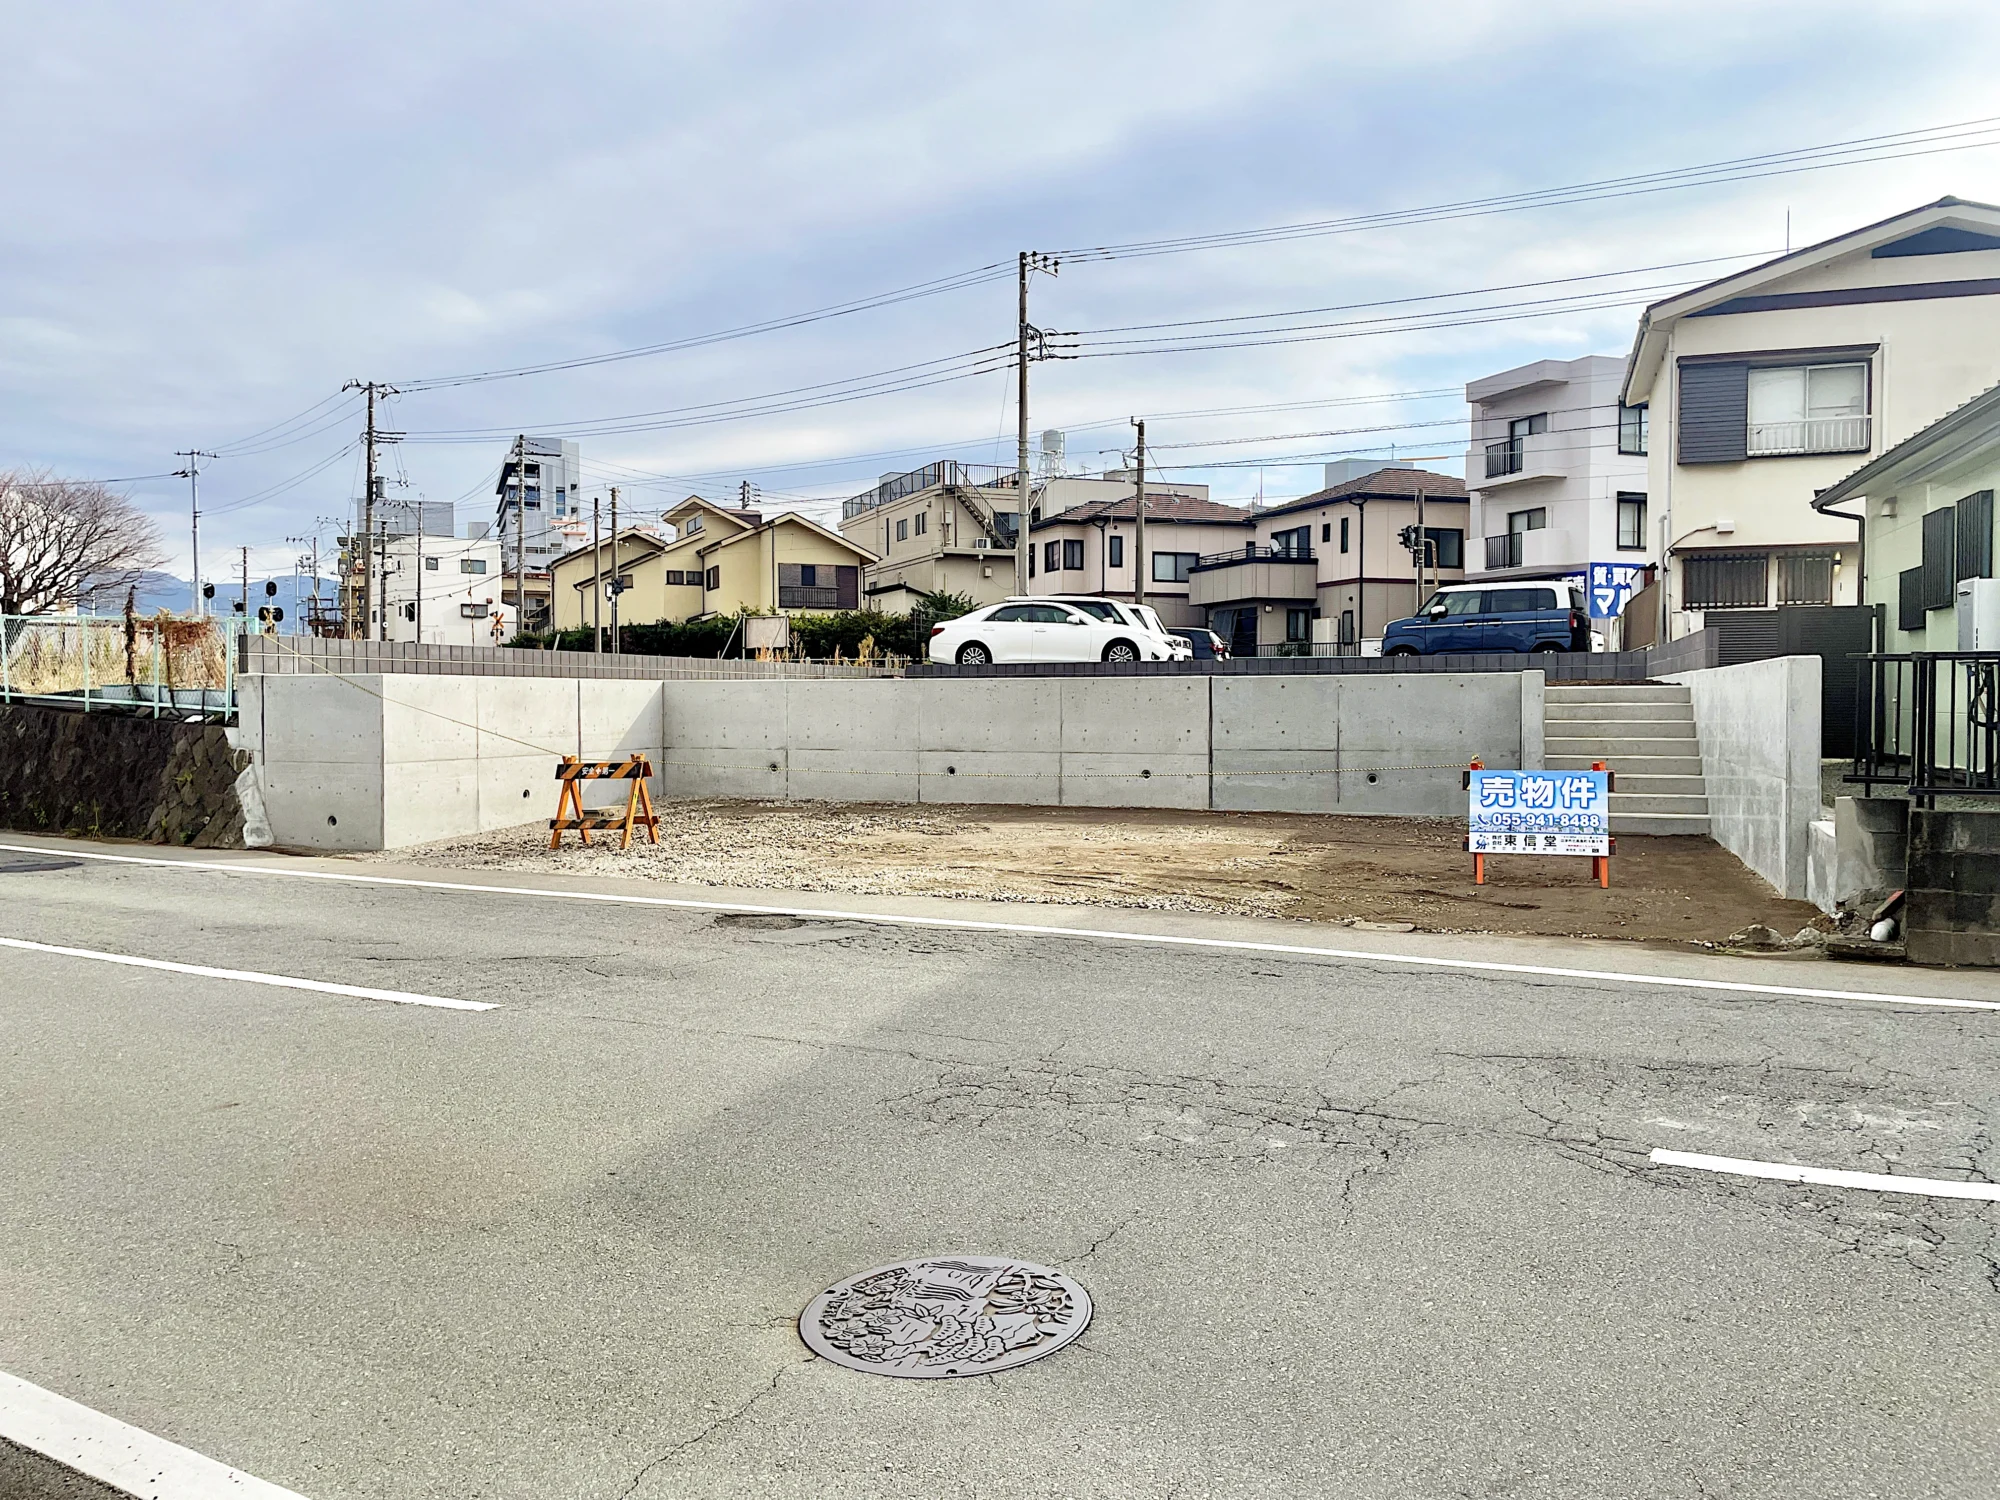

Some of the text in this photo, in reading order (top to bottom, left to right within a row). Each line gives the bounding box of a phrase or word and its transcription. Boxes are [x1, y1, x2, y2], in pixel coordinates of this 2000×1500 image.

[1481, 776, 1596, 808] 売物件
[1491, 813, 1600, 828] 055-941-8488
[1504, 834, 1557, 847] 東信堂
